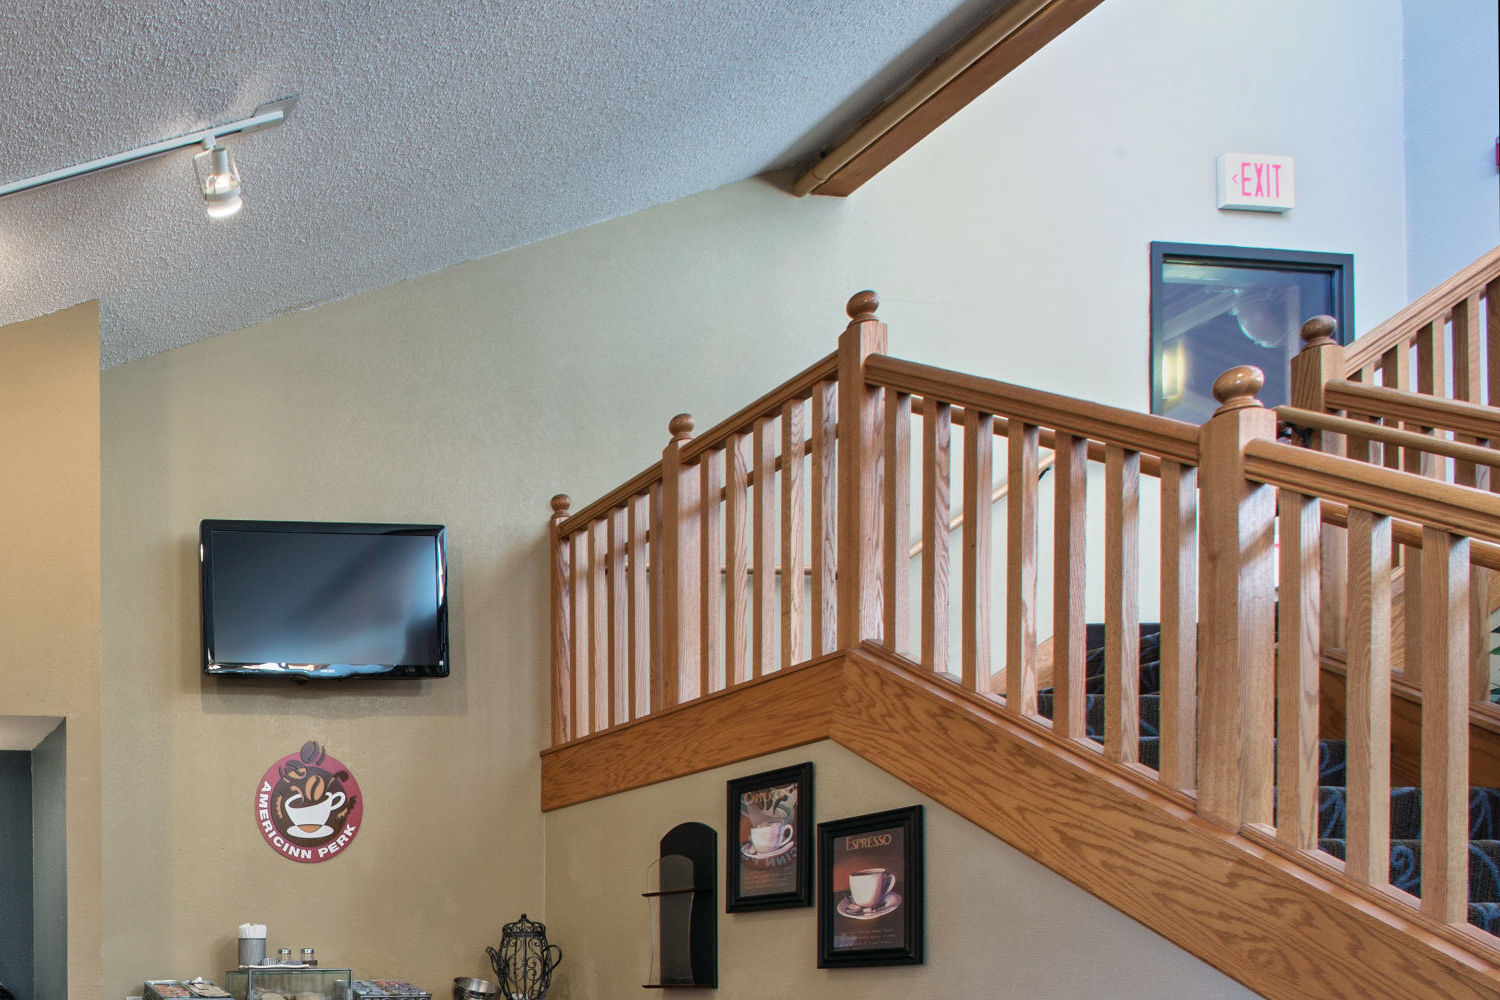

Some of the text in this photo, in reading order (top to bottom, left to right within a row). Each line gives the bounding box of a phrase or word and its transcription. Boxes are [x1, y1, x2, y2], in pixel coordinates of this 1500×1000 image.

[1241, 162, 1282, 198] EXIT
[257, 780, 356, 859] AMERICINN PERK
[845, 834, 892, 851] ESPRESSO
